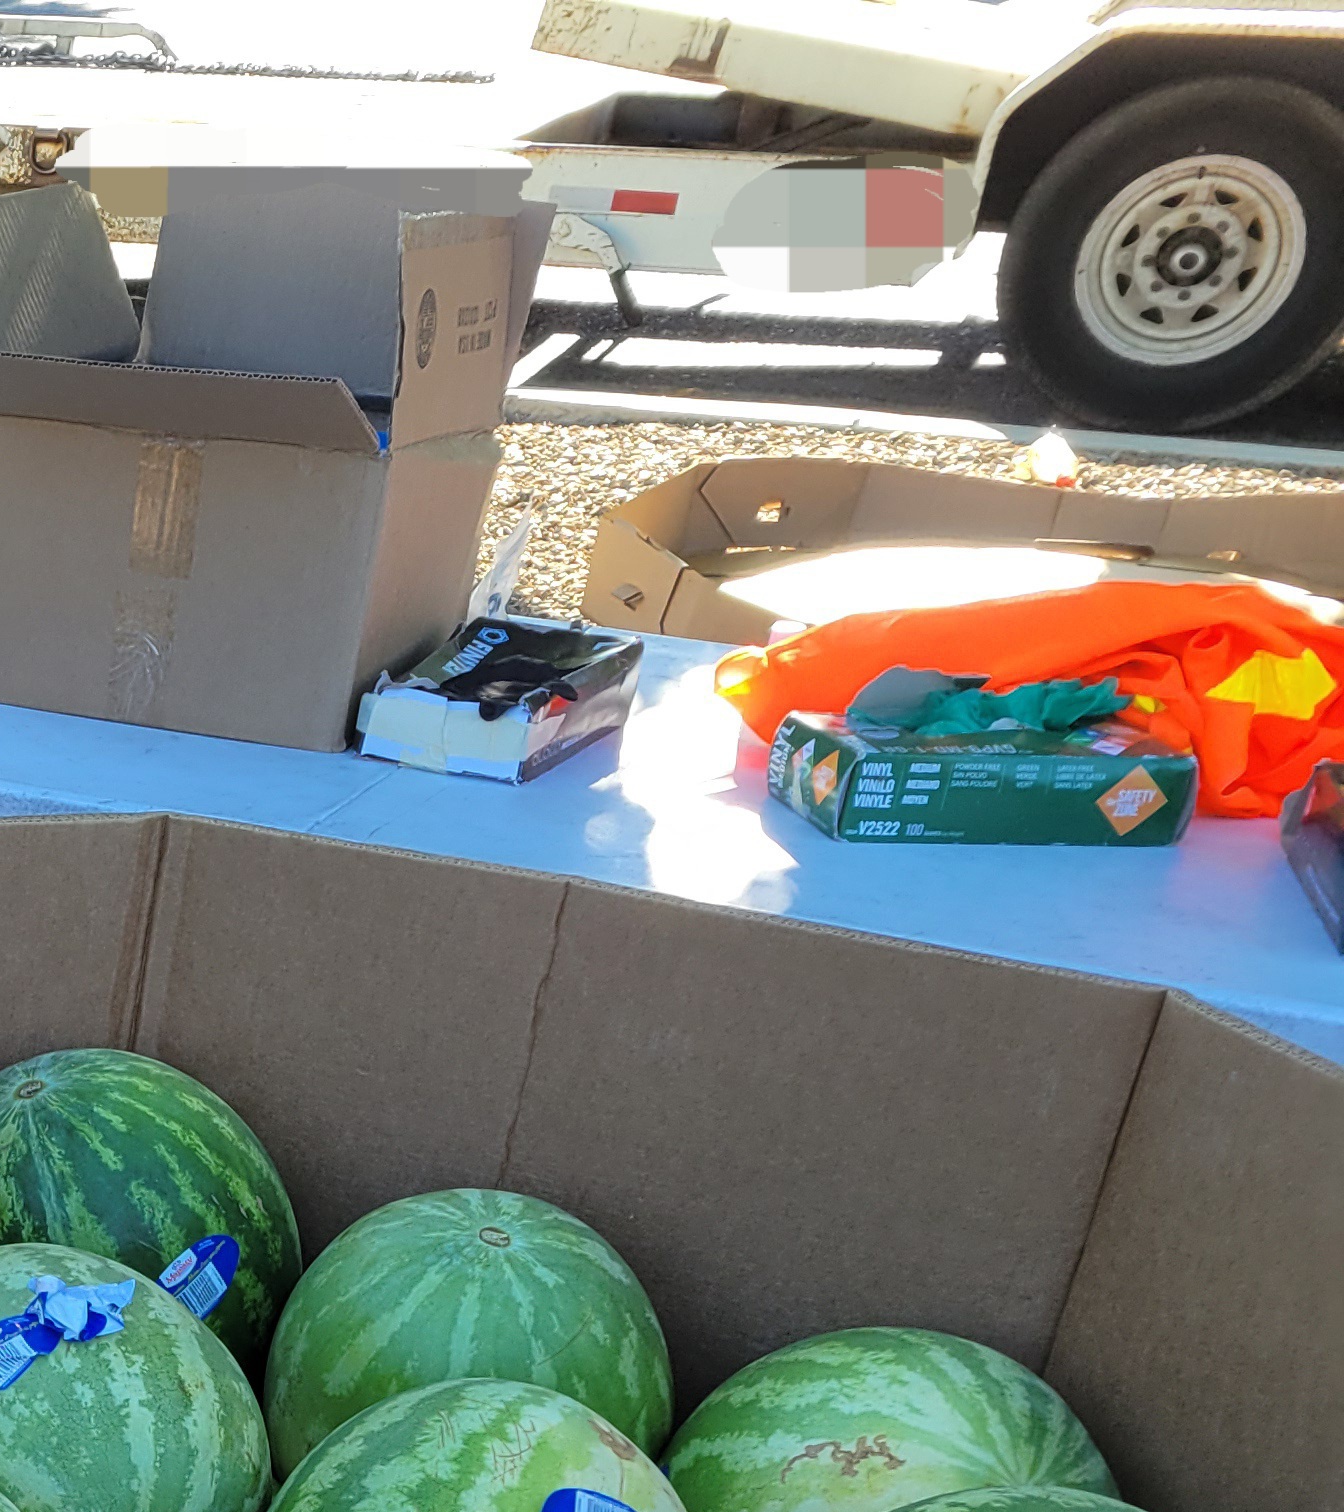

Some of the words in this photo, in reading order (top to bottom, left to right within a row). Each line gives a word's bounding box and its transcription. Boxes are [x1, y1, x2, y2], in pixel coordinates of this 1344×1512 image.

[769, 725, 796, 783] VINYL
[863, 762, 893, 776] VINYL
[858, 778, 895, 792] VINILO
[853, 794, 894, 808] VINYLE
[859, 821, 900, 836] V2522
[906, 823, 924, 836] 100
